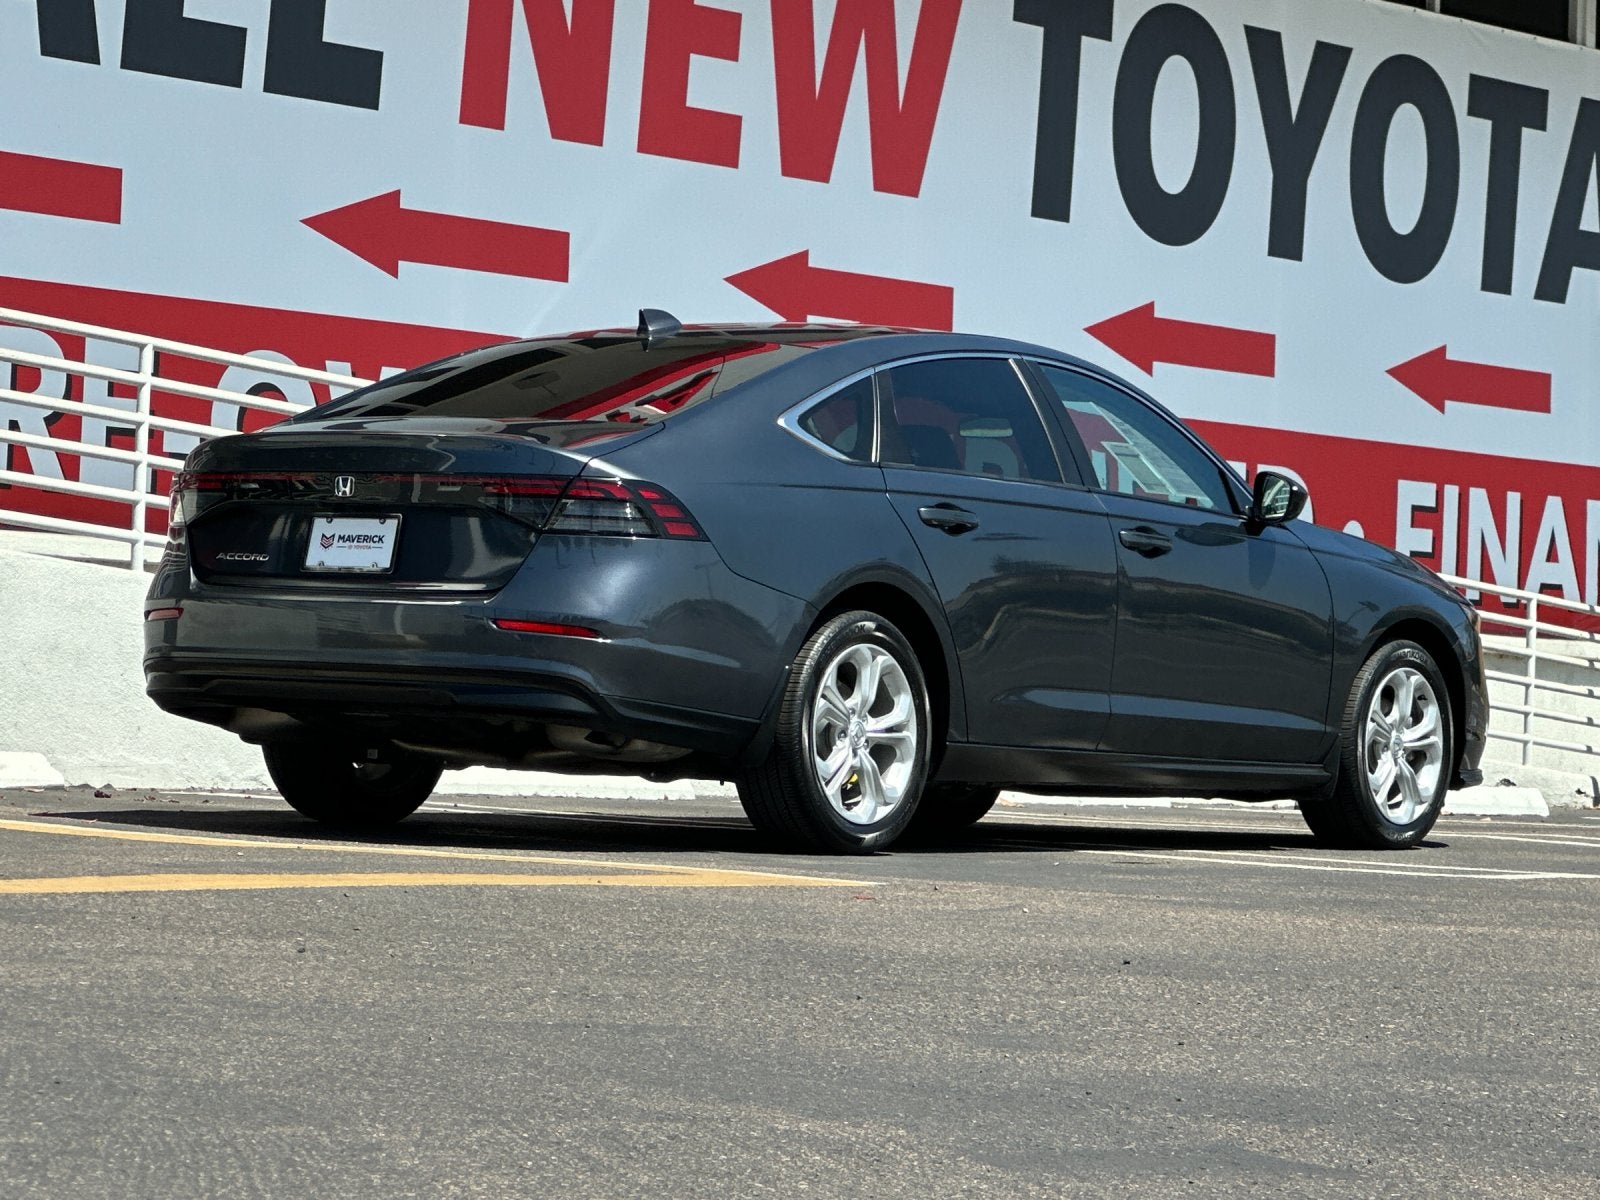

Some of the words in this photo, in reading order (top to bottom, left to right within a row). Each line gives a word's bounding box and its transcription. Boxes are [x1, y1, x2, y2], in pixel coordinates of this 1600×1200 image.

[459, 0, 962, 198] NEW
[337, 534, 386, 544] MAVERICK
[215, 552, 270, 561] ACCORD
